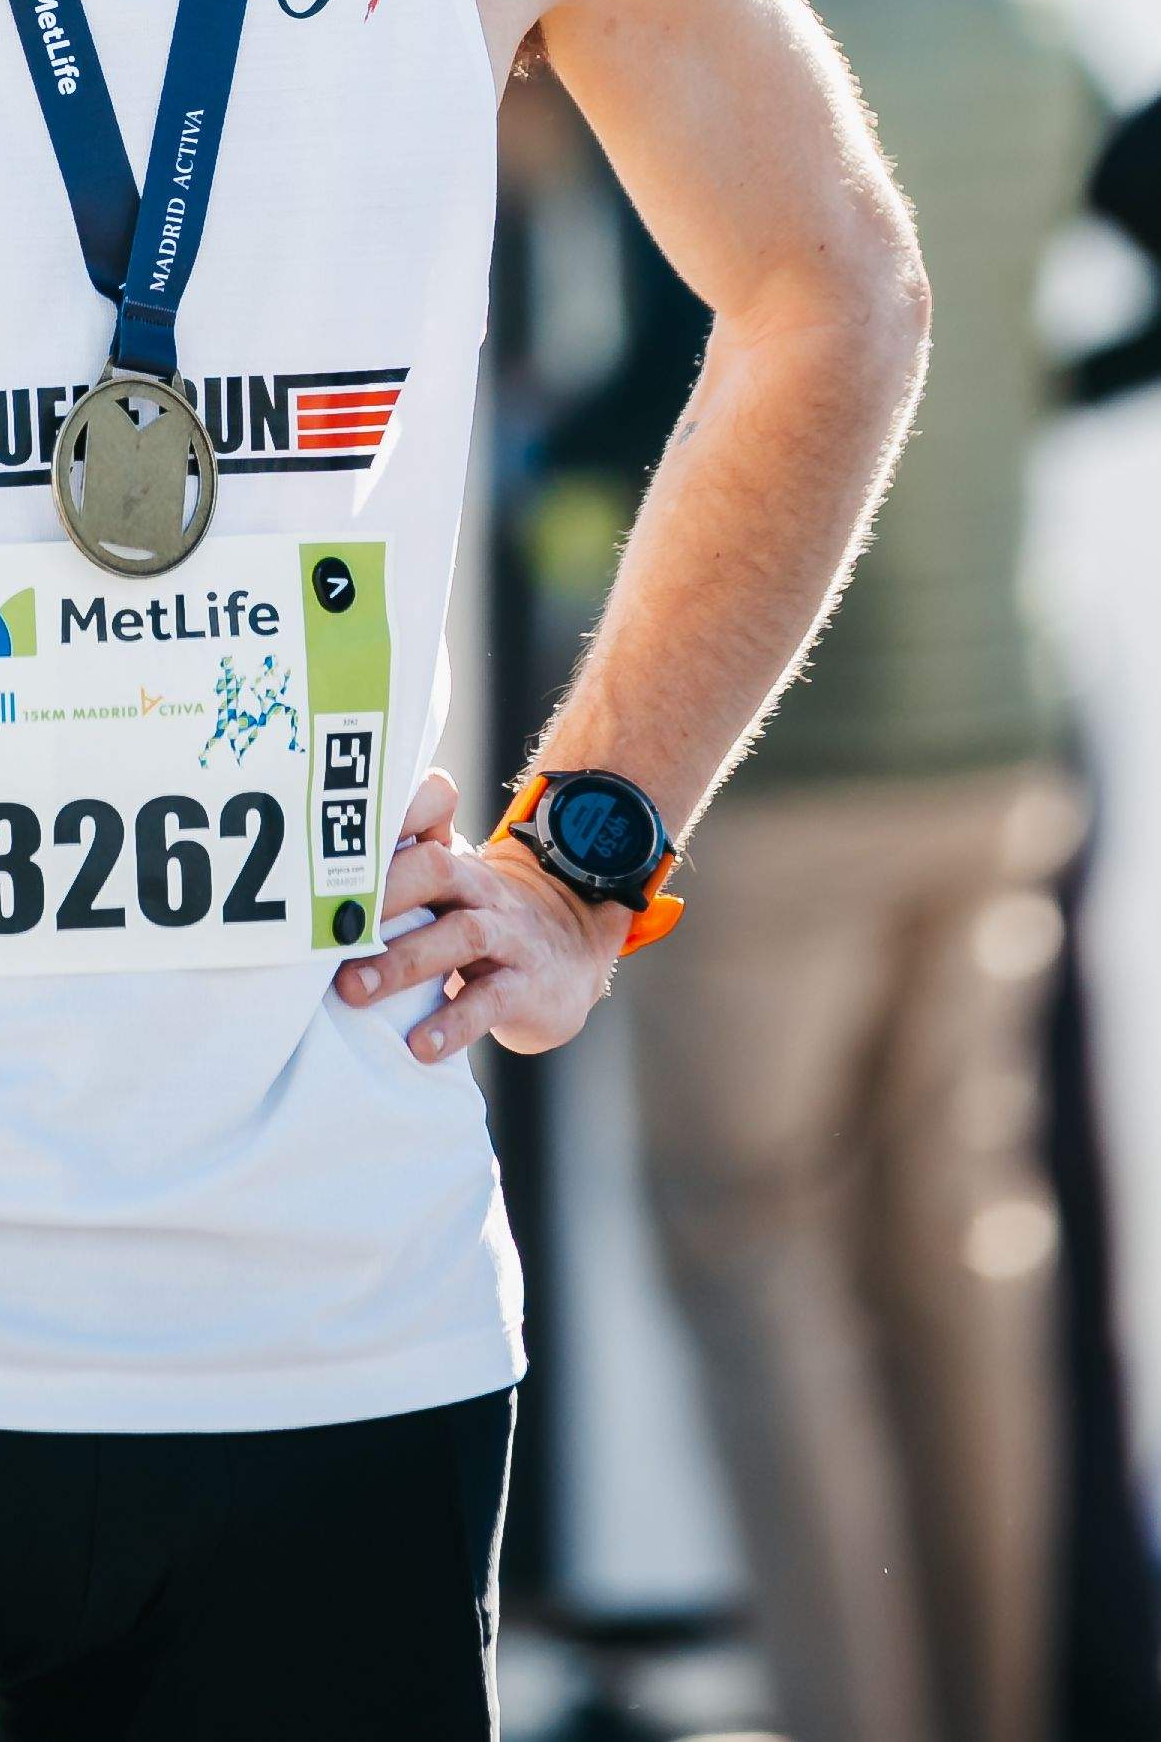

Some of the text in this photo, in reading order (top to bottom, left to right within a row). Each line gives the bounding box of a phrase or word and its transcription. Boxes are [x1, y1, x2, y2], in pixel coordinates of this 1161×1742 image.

[149, 109, 205, 293] MADRID ACTIVA
[61, 590, 280, 644] MetLife
[23, 709, 66, 722] 15KM
[72, 705, 138, 719] MADRID
